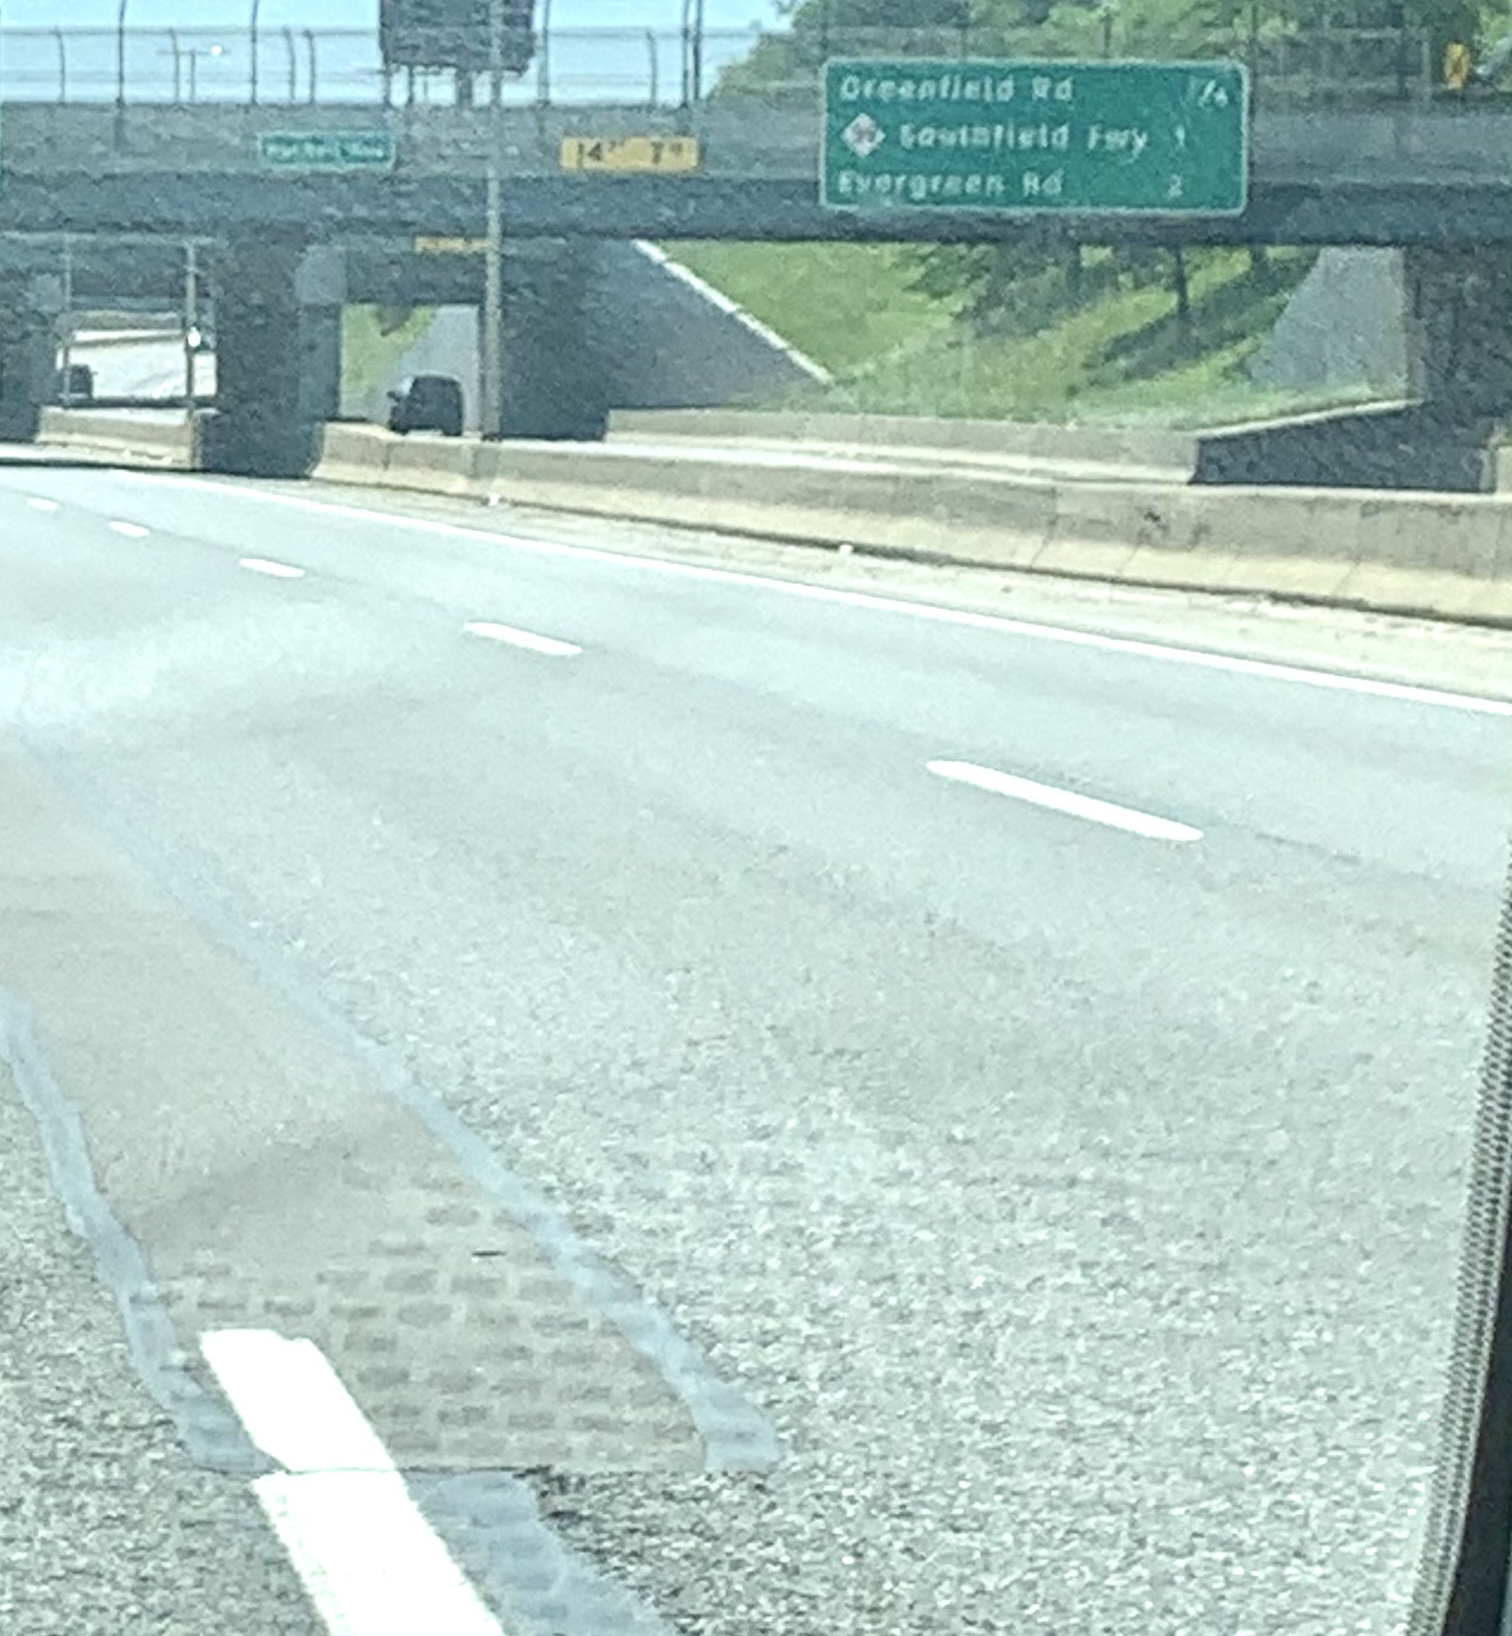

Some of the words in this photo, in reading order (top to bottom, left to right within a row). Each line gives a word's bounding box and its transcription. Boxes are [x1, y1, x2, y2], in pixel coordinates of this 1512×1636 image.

[840, 74, 1015, 102] Greenfield
[1032, 75, 1073, 101] Rd
[577, 141, 603, 168] 14
[651, 141, 665, 164] 7
[900, 122, 1070, 151] Southfield
[1088, 124, 1148, 161] Fwy
[1174, 124, 1187, 150] 1
[838, 170, 1006, 201] Evergreen
[1022, 168, 1065, 197] Rd
